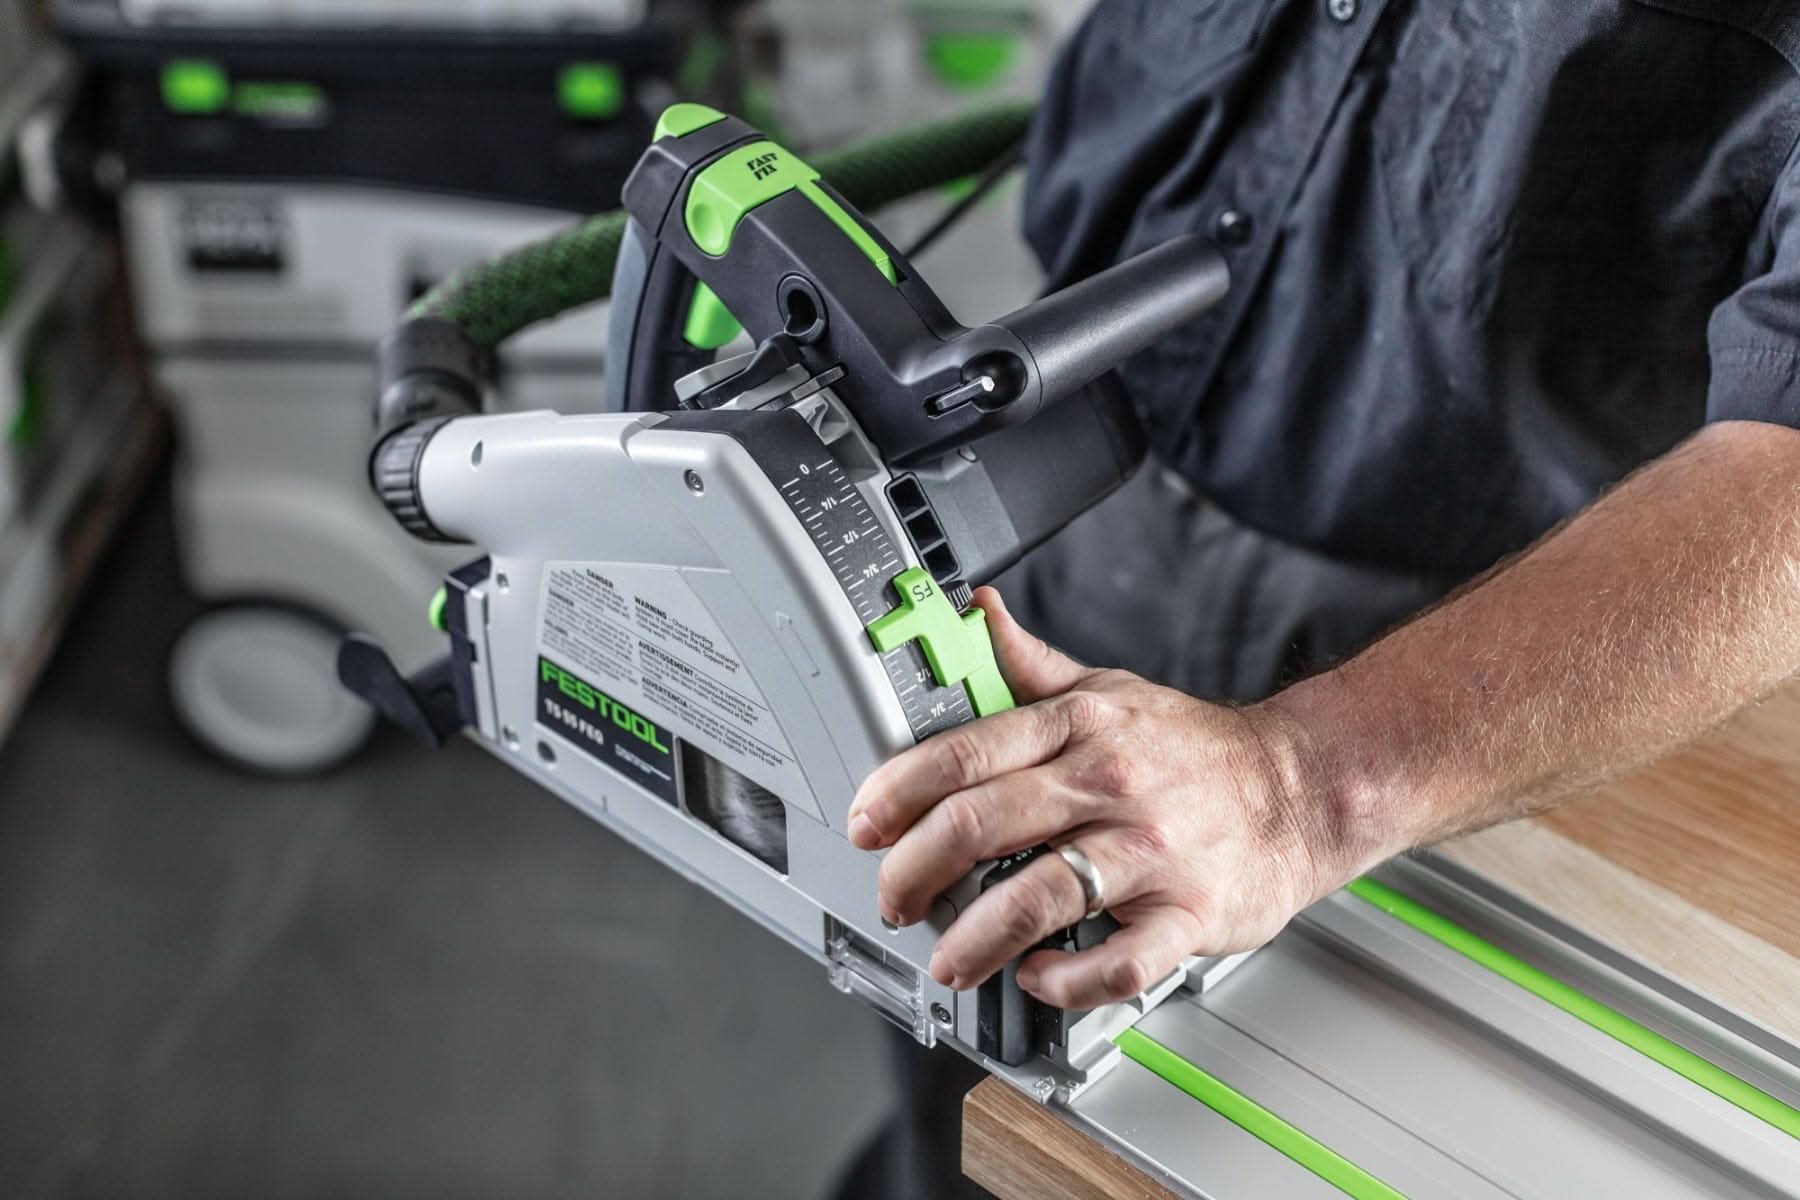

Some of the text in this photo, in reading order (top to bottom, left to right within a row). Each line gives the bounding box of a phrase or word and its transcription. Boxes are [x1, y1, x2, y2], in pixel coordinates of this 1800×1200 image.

[747, 152, 778, 171] FAST
[754, 164, 777, 181] FIX
[799, 463, 810, 475] 0
[820, 495, 838, 511] 1/4
[842, 529, 860, 545] 1/2
[862, 563, 880, 578] 3/4
[912, 579, 935, 602] FS
[634, 594, 667, 620] WARNING
[637, 638, 694, 678] AVERTISSEMENT
[541, 659, 669, 754] FESTOOL
[930, 702, 947, 718] 3/4
